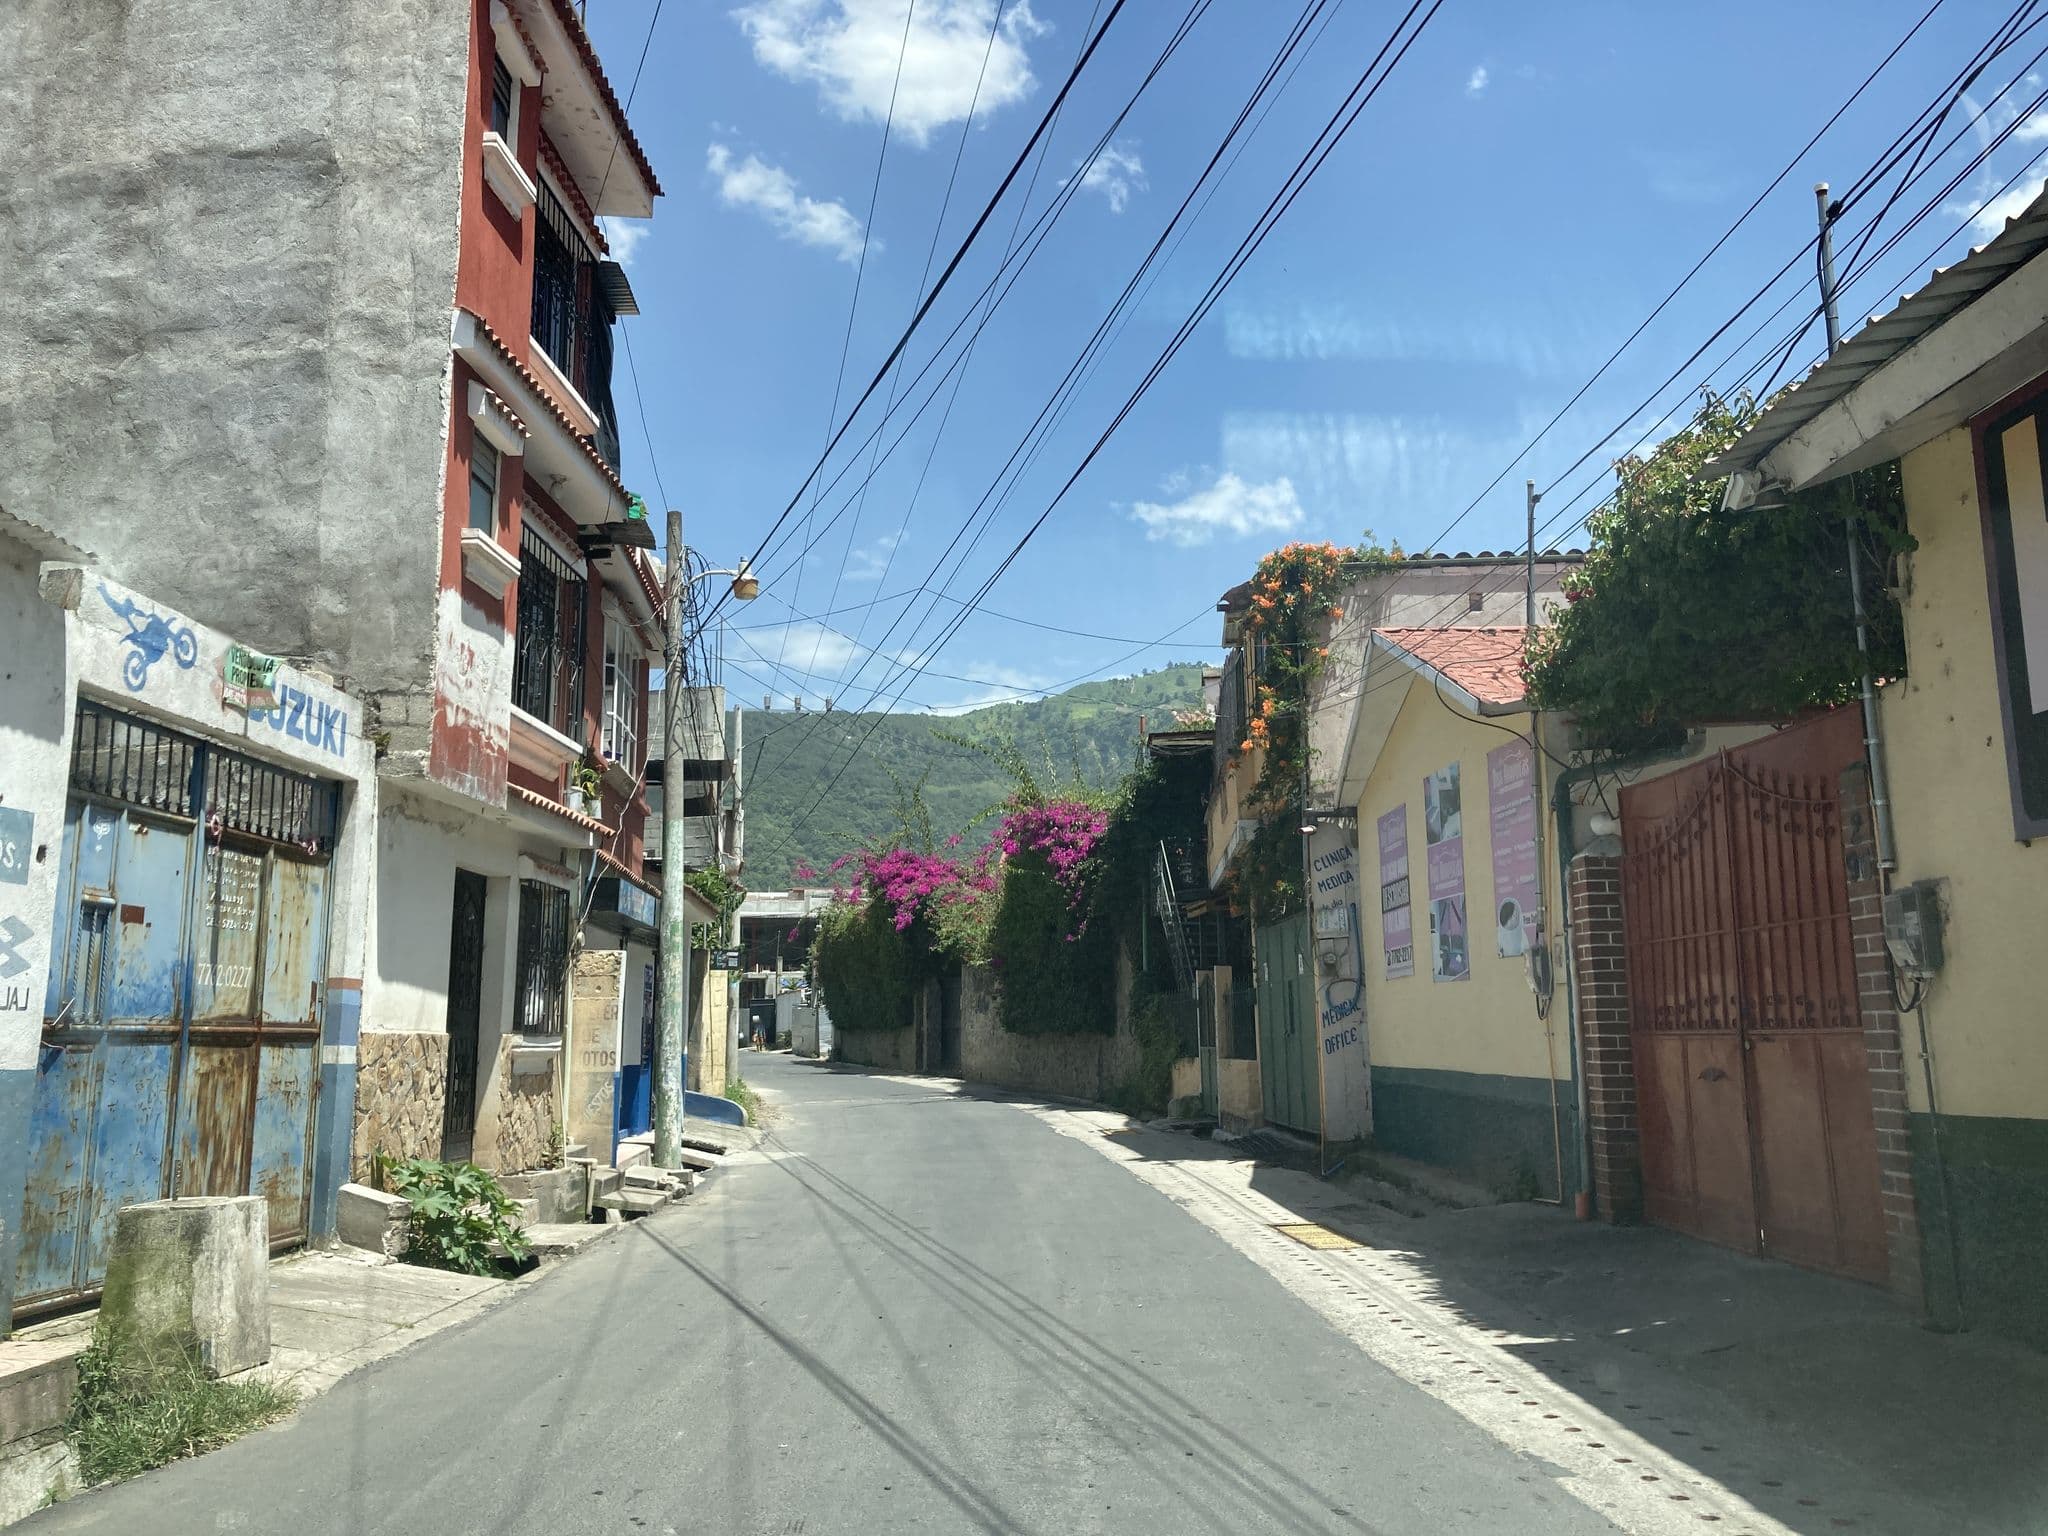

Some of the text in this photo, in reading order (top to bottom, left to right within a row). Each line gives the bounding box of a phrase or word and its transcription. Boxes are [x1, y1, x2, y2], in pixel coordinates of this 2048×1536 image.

[248, 684, 347, 758] UZUKI
[1313, 846, 1353, 872] CLINICA
[1317, 870, 1354, 893] MEDICA
[1325, 1027, 1357, 1055] OFFICE
